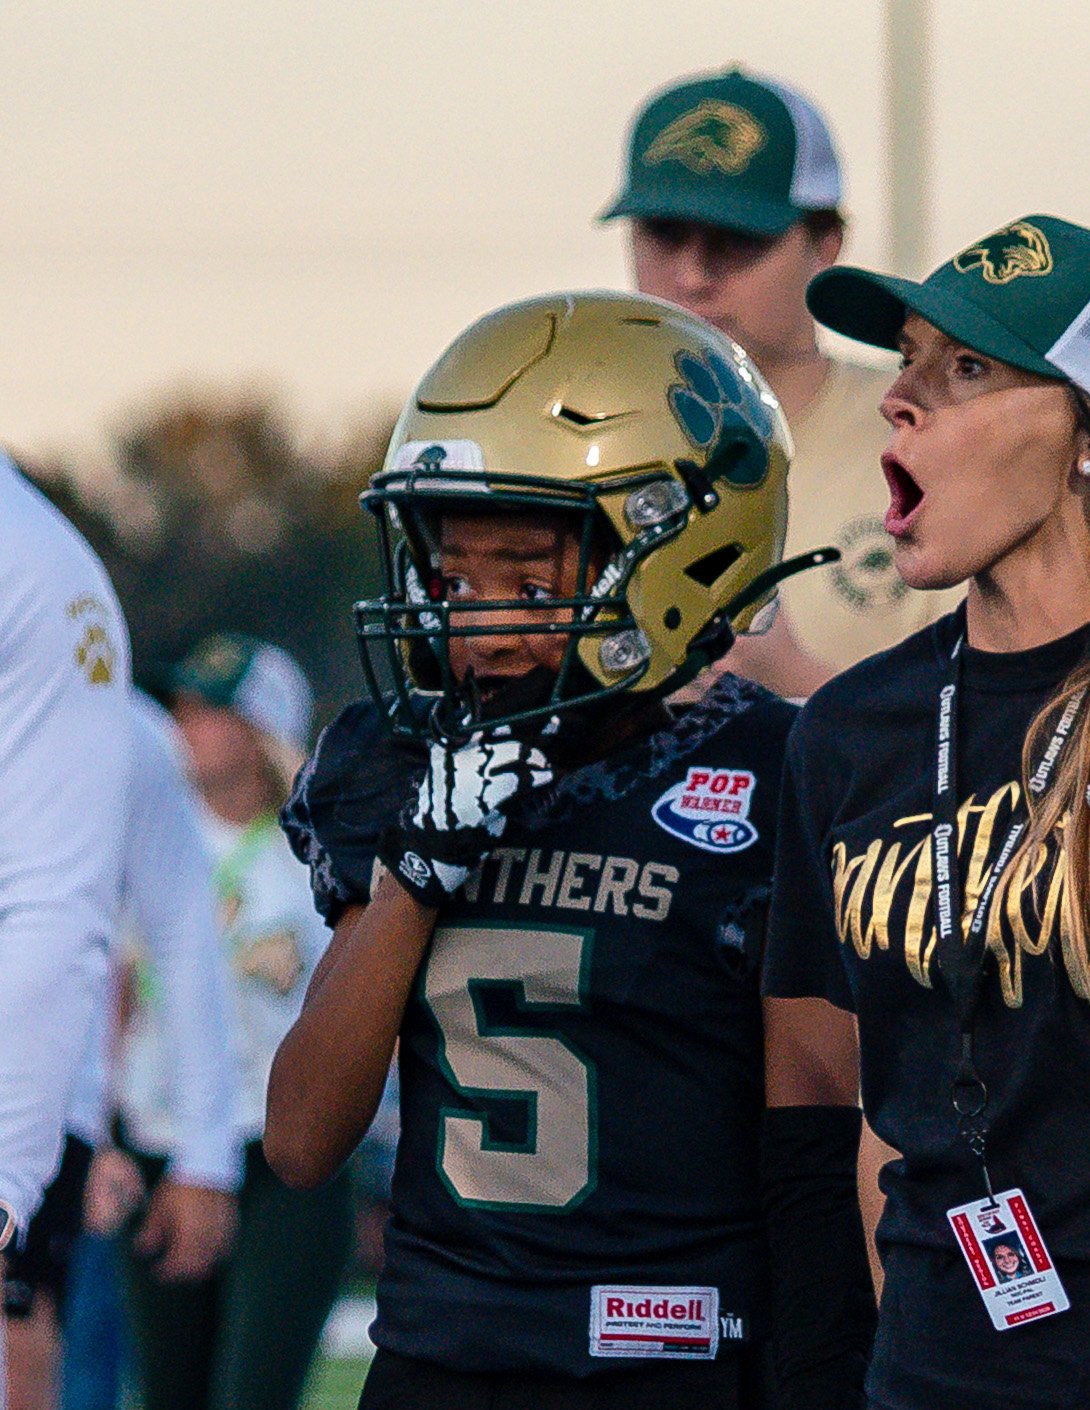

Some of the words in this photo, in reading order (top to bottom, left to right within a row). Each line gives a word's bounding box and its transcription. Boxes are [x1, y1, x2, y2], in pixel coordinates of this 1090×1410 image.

[686, 772, 751, 796] POP
[937, 741, 950, 796] FOOTBALL
[933, 823, 954, 882] OUTLAWS
[465, 848, 680, 922] THERS
[937, 883, 953, 939] FOOTBALL
[422, 921, 597, 1212] 5
[606, 1298, 702, 1321] Riddell
[720, 1317, 743, 1339] YM
